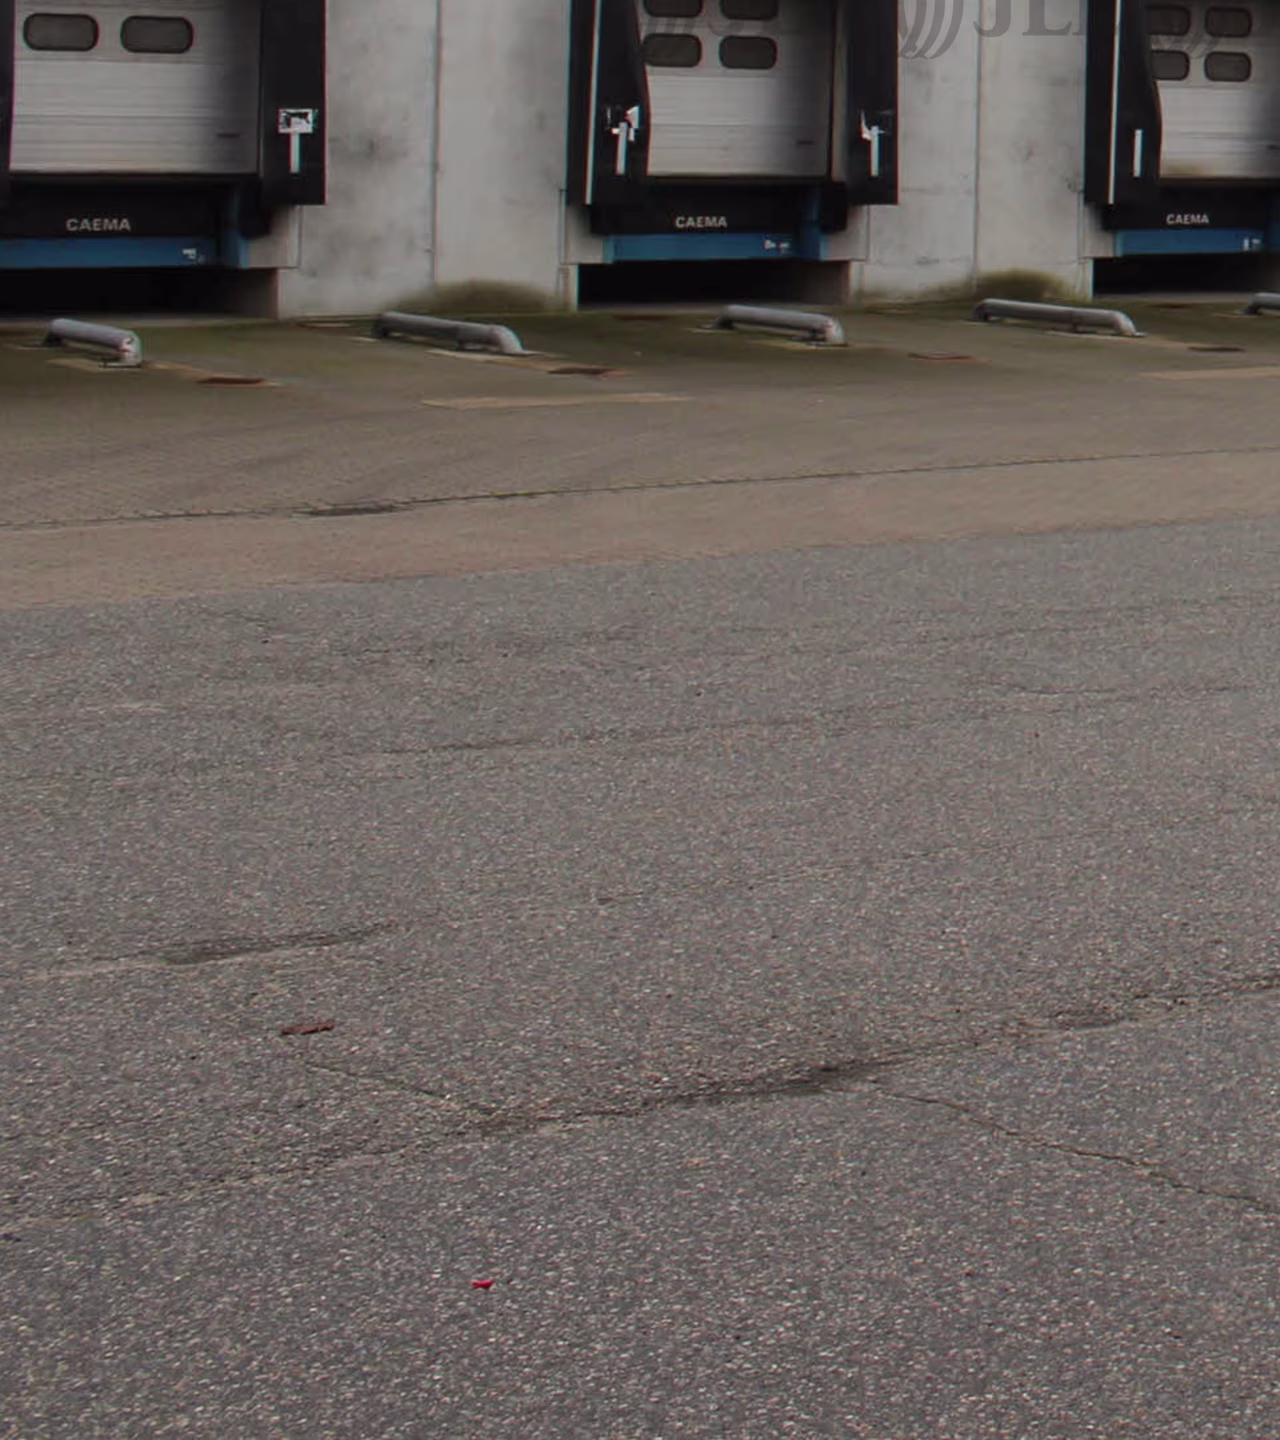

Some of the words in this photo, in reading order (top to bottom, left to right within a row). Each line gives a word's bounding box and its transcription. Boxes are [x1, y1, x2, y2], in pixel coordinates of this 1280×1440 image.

[66, 218, 131, 232] CAEMA
[675, 216, 728, 228] CAEMA
[1166, 213, 1210, 225] CAEMA
